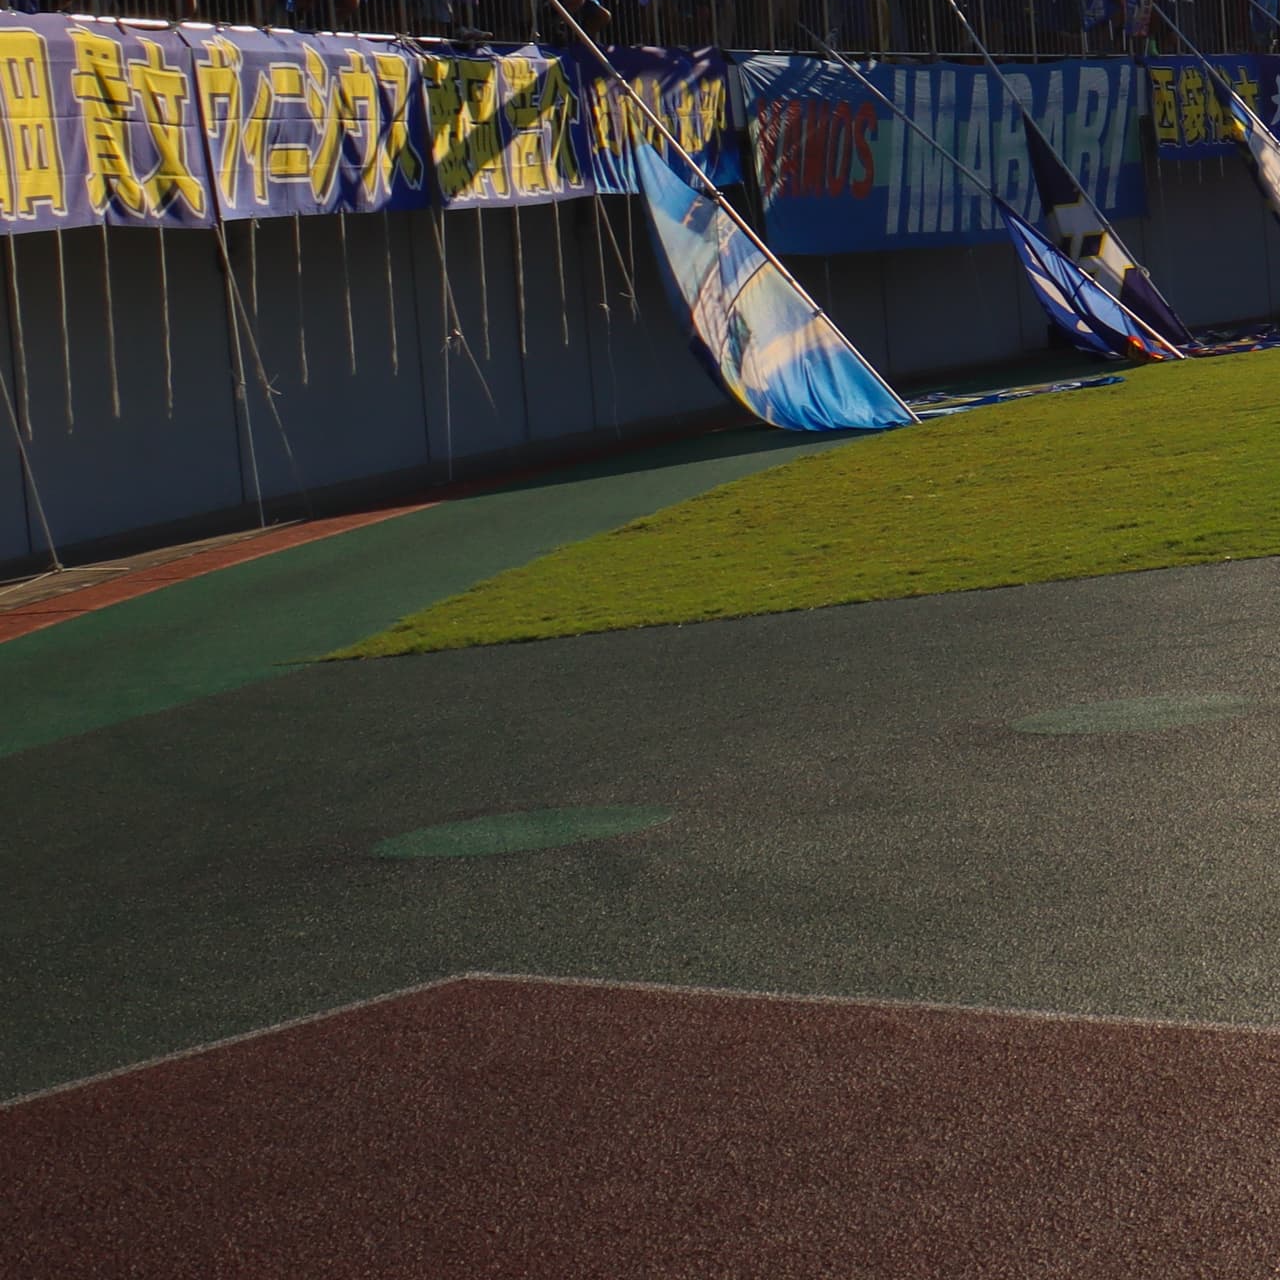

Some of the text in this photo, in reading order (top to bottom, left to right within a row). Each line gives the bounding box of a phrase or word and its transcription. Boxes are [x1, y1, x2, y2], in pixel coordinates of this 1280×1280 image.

[0, 24, 207, 220] 田貴文
[886, 64, 1132, 235] IMABARI
